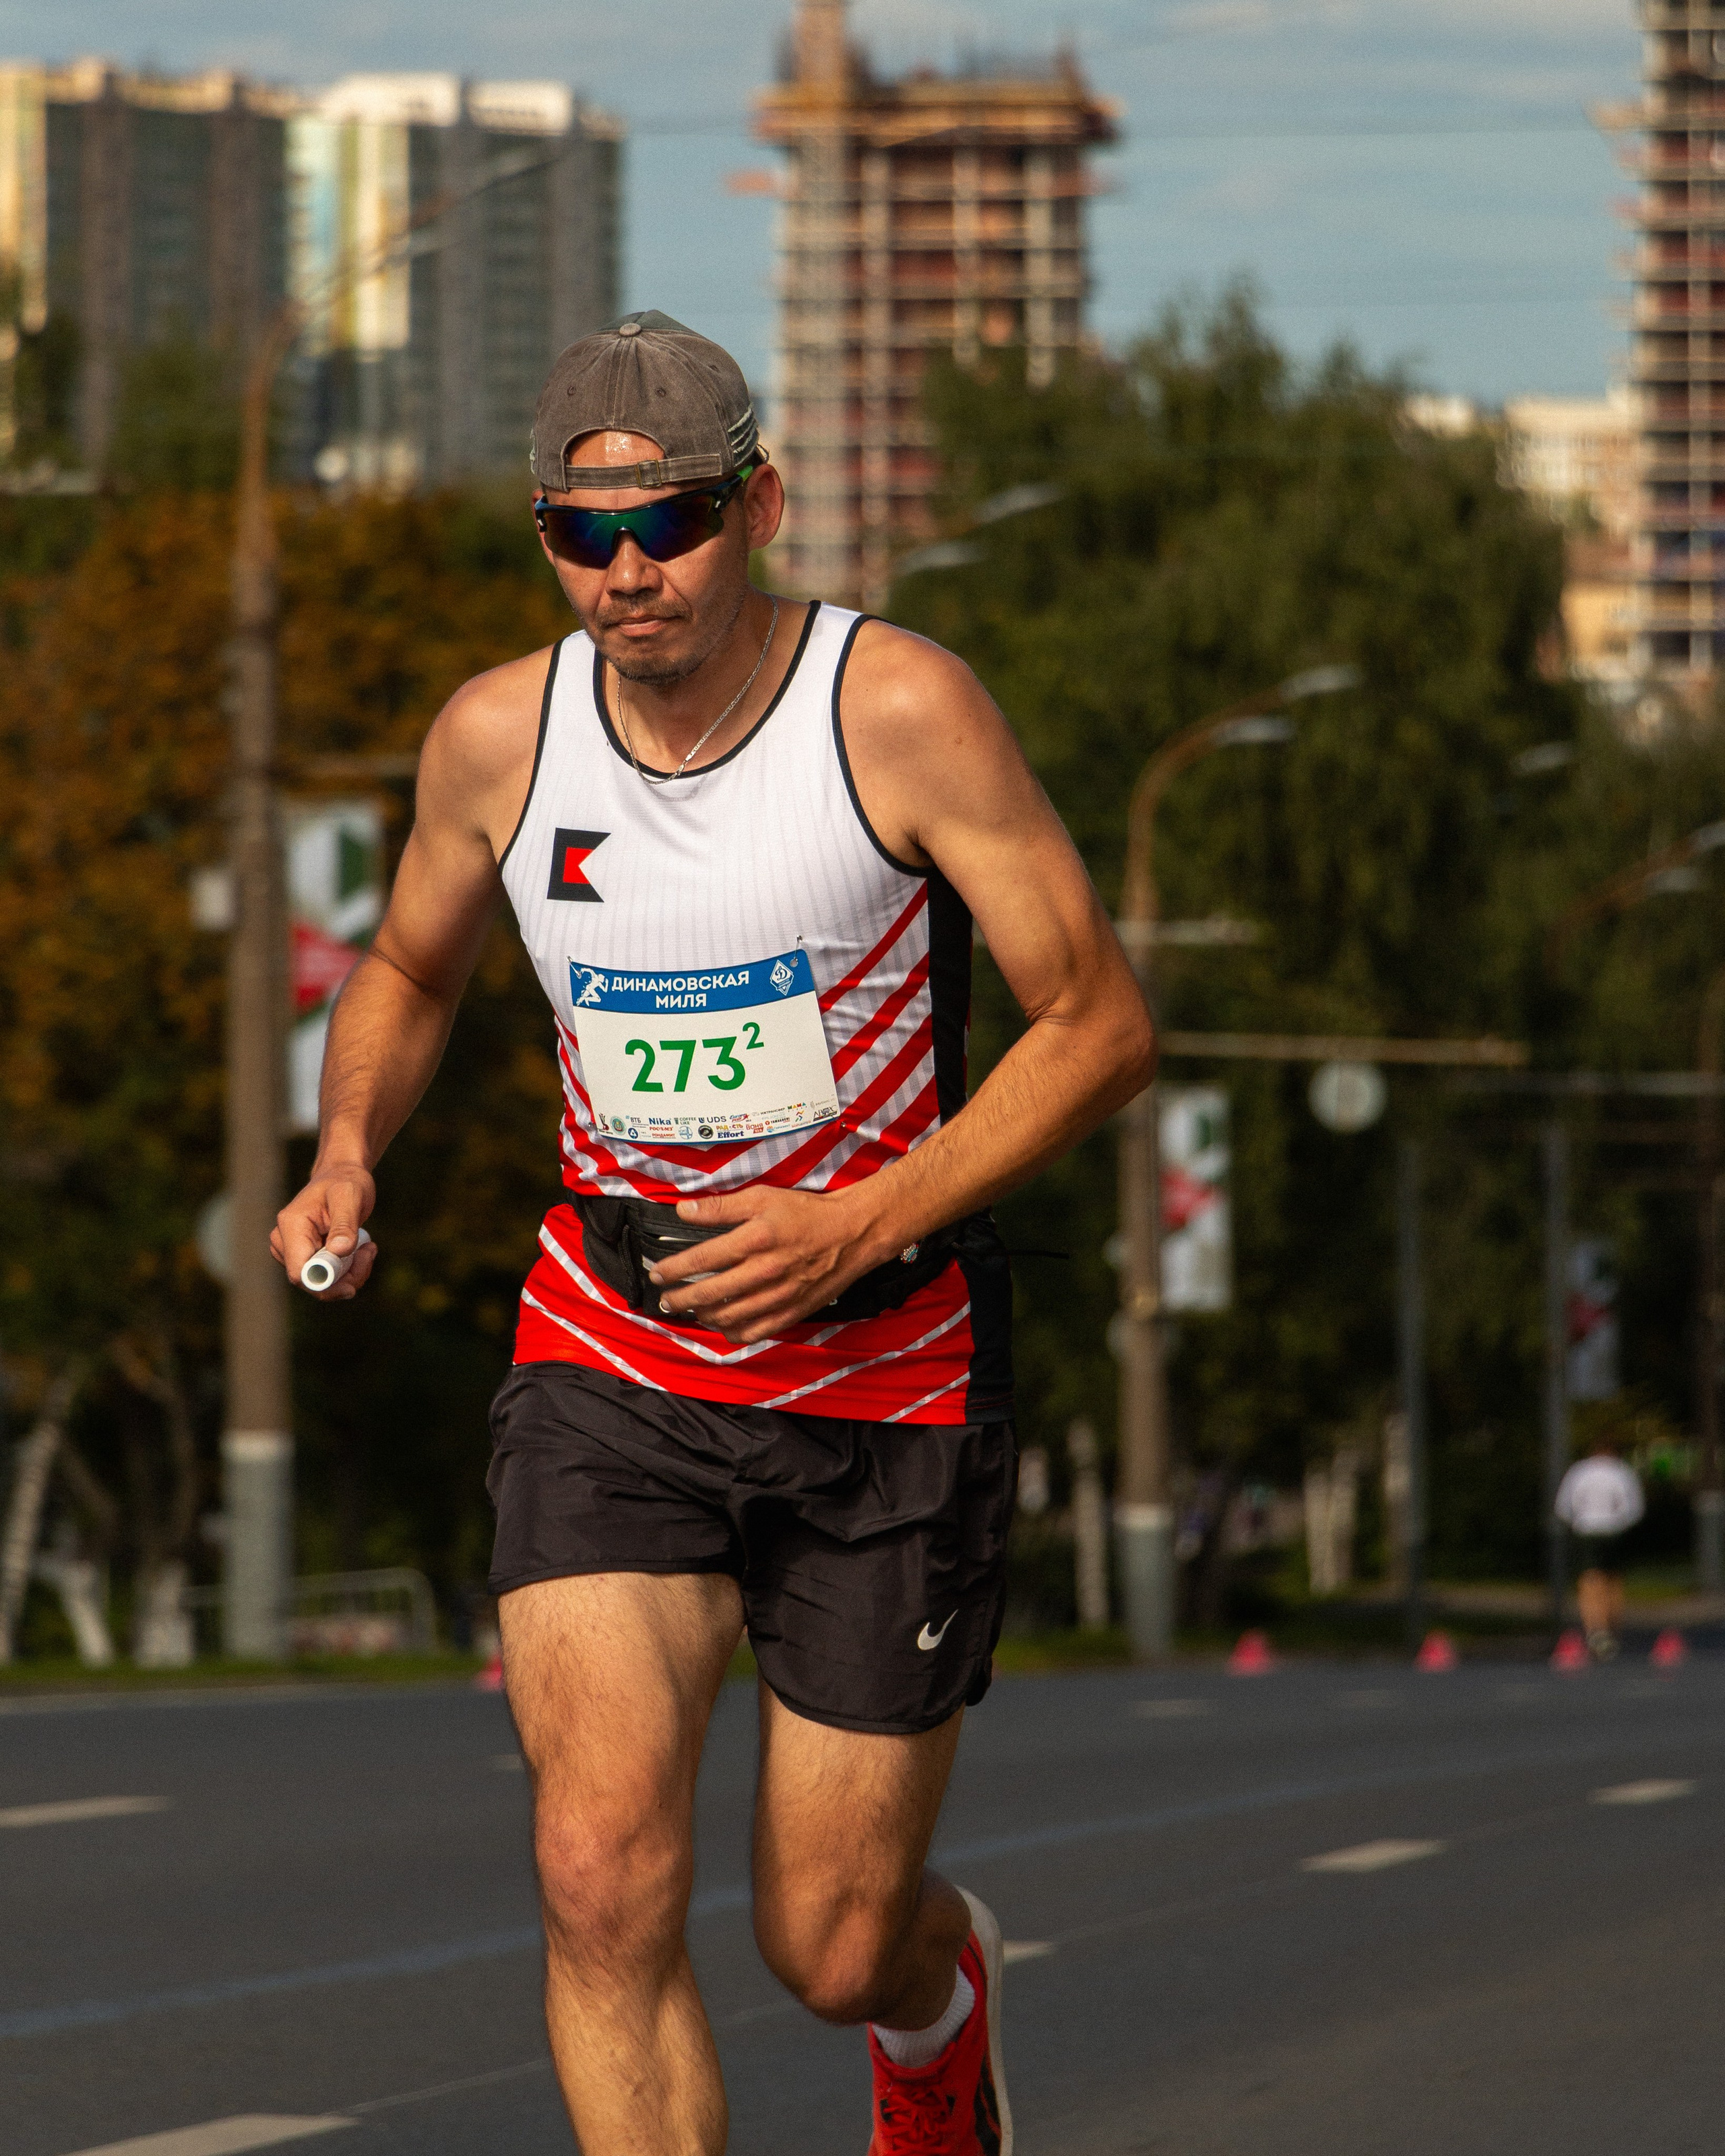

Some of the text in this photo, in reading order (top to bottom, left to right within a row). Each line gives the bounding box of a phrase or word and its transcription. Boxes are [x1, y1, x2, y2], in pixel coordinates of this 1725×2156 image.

[611, 970, 749, 992] ДИНАМОВСКАЯ
[656, 993, 707, 1009] МИЛЯ
[648, 1117, 672, 1125] Nika
[706, 1116, 727, 1124] UDS
[717, 1131, 745, 1139] Effort
